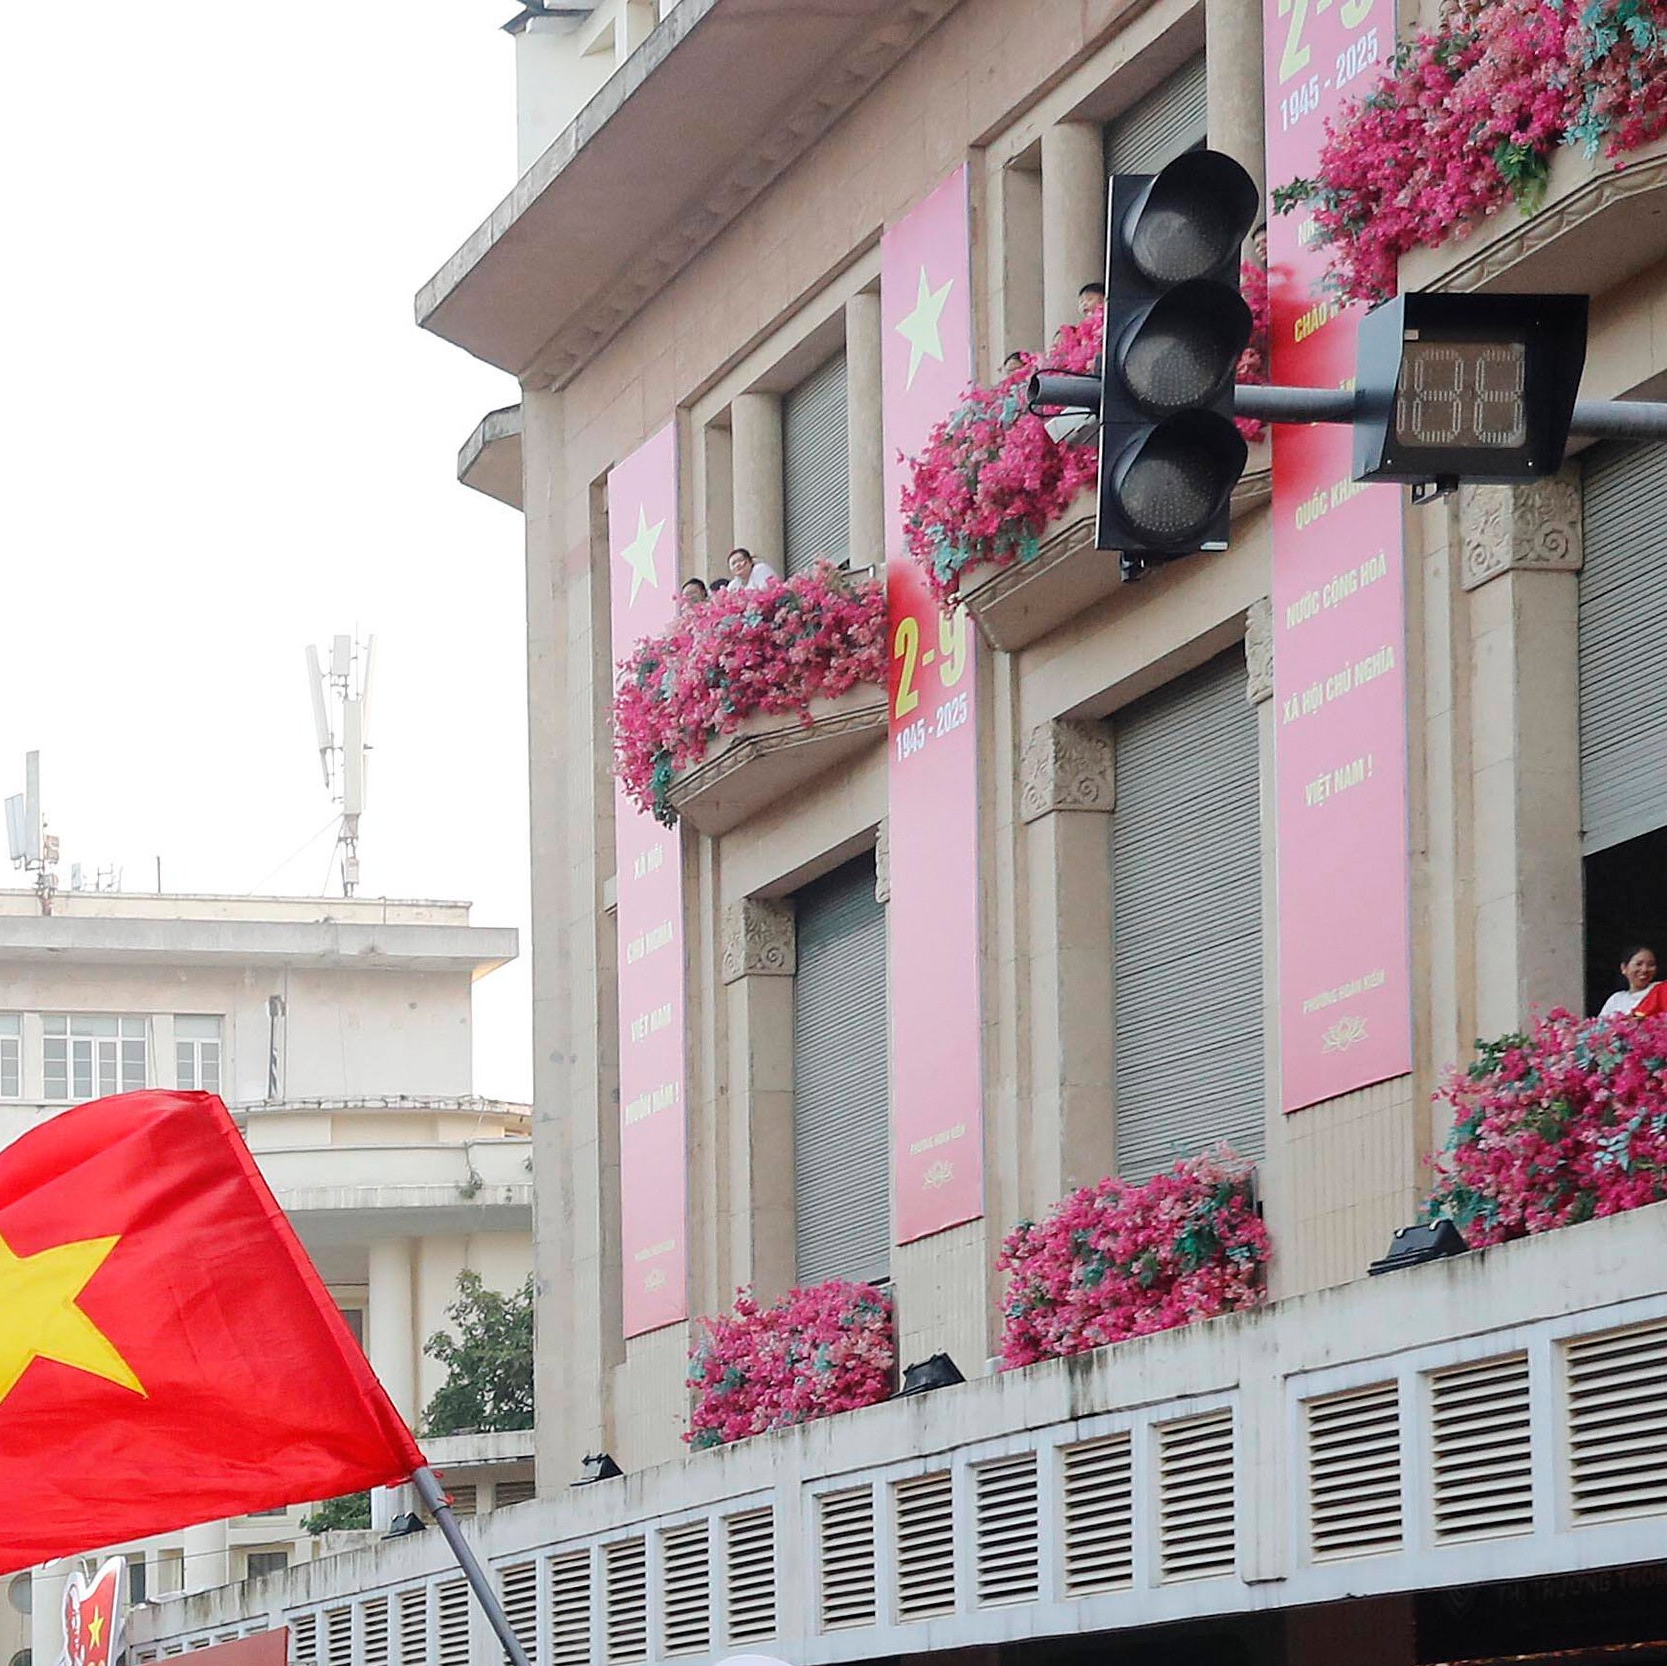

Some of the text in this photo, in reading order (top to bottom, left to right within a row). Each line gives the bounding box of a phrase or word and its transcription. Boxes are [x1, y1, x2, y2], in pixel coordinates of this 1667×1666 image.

[1279, 74, 1320, 131] 1945
[1336, 28, 1378, 90] 2025
[1295, 487, 1328, 530] QUỐC
[1286, 590, 1320, 630] NƯỚC
[1323, 572, 1358, 609] CỘNG
[894, 602, 967, 719] 2-9
[1283, 645, 1396, 724] XÃ HỘI CHỦ NGHĨA
[896, 718, 925, 762] 1945
[936, 692, 967, 739] 2025
[1306, 771, 1332, 807] VIỆT
[1334, 757, 1365, 793] NAM
